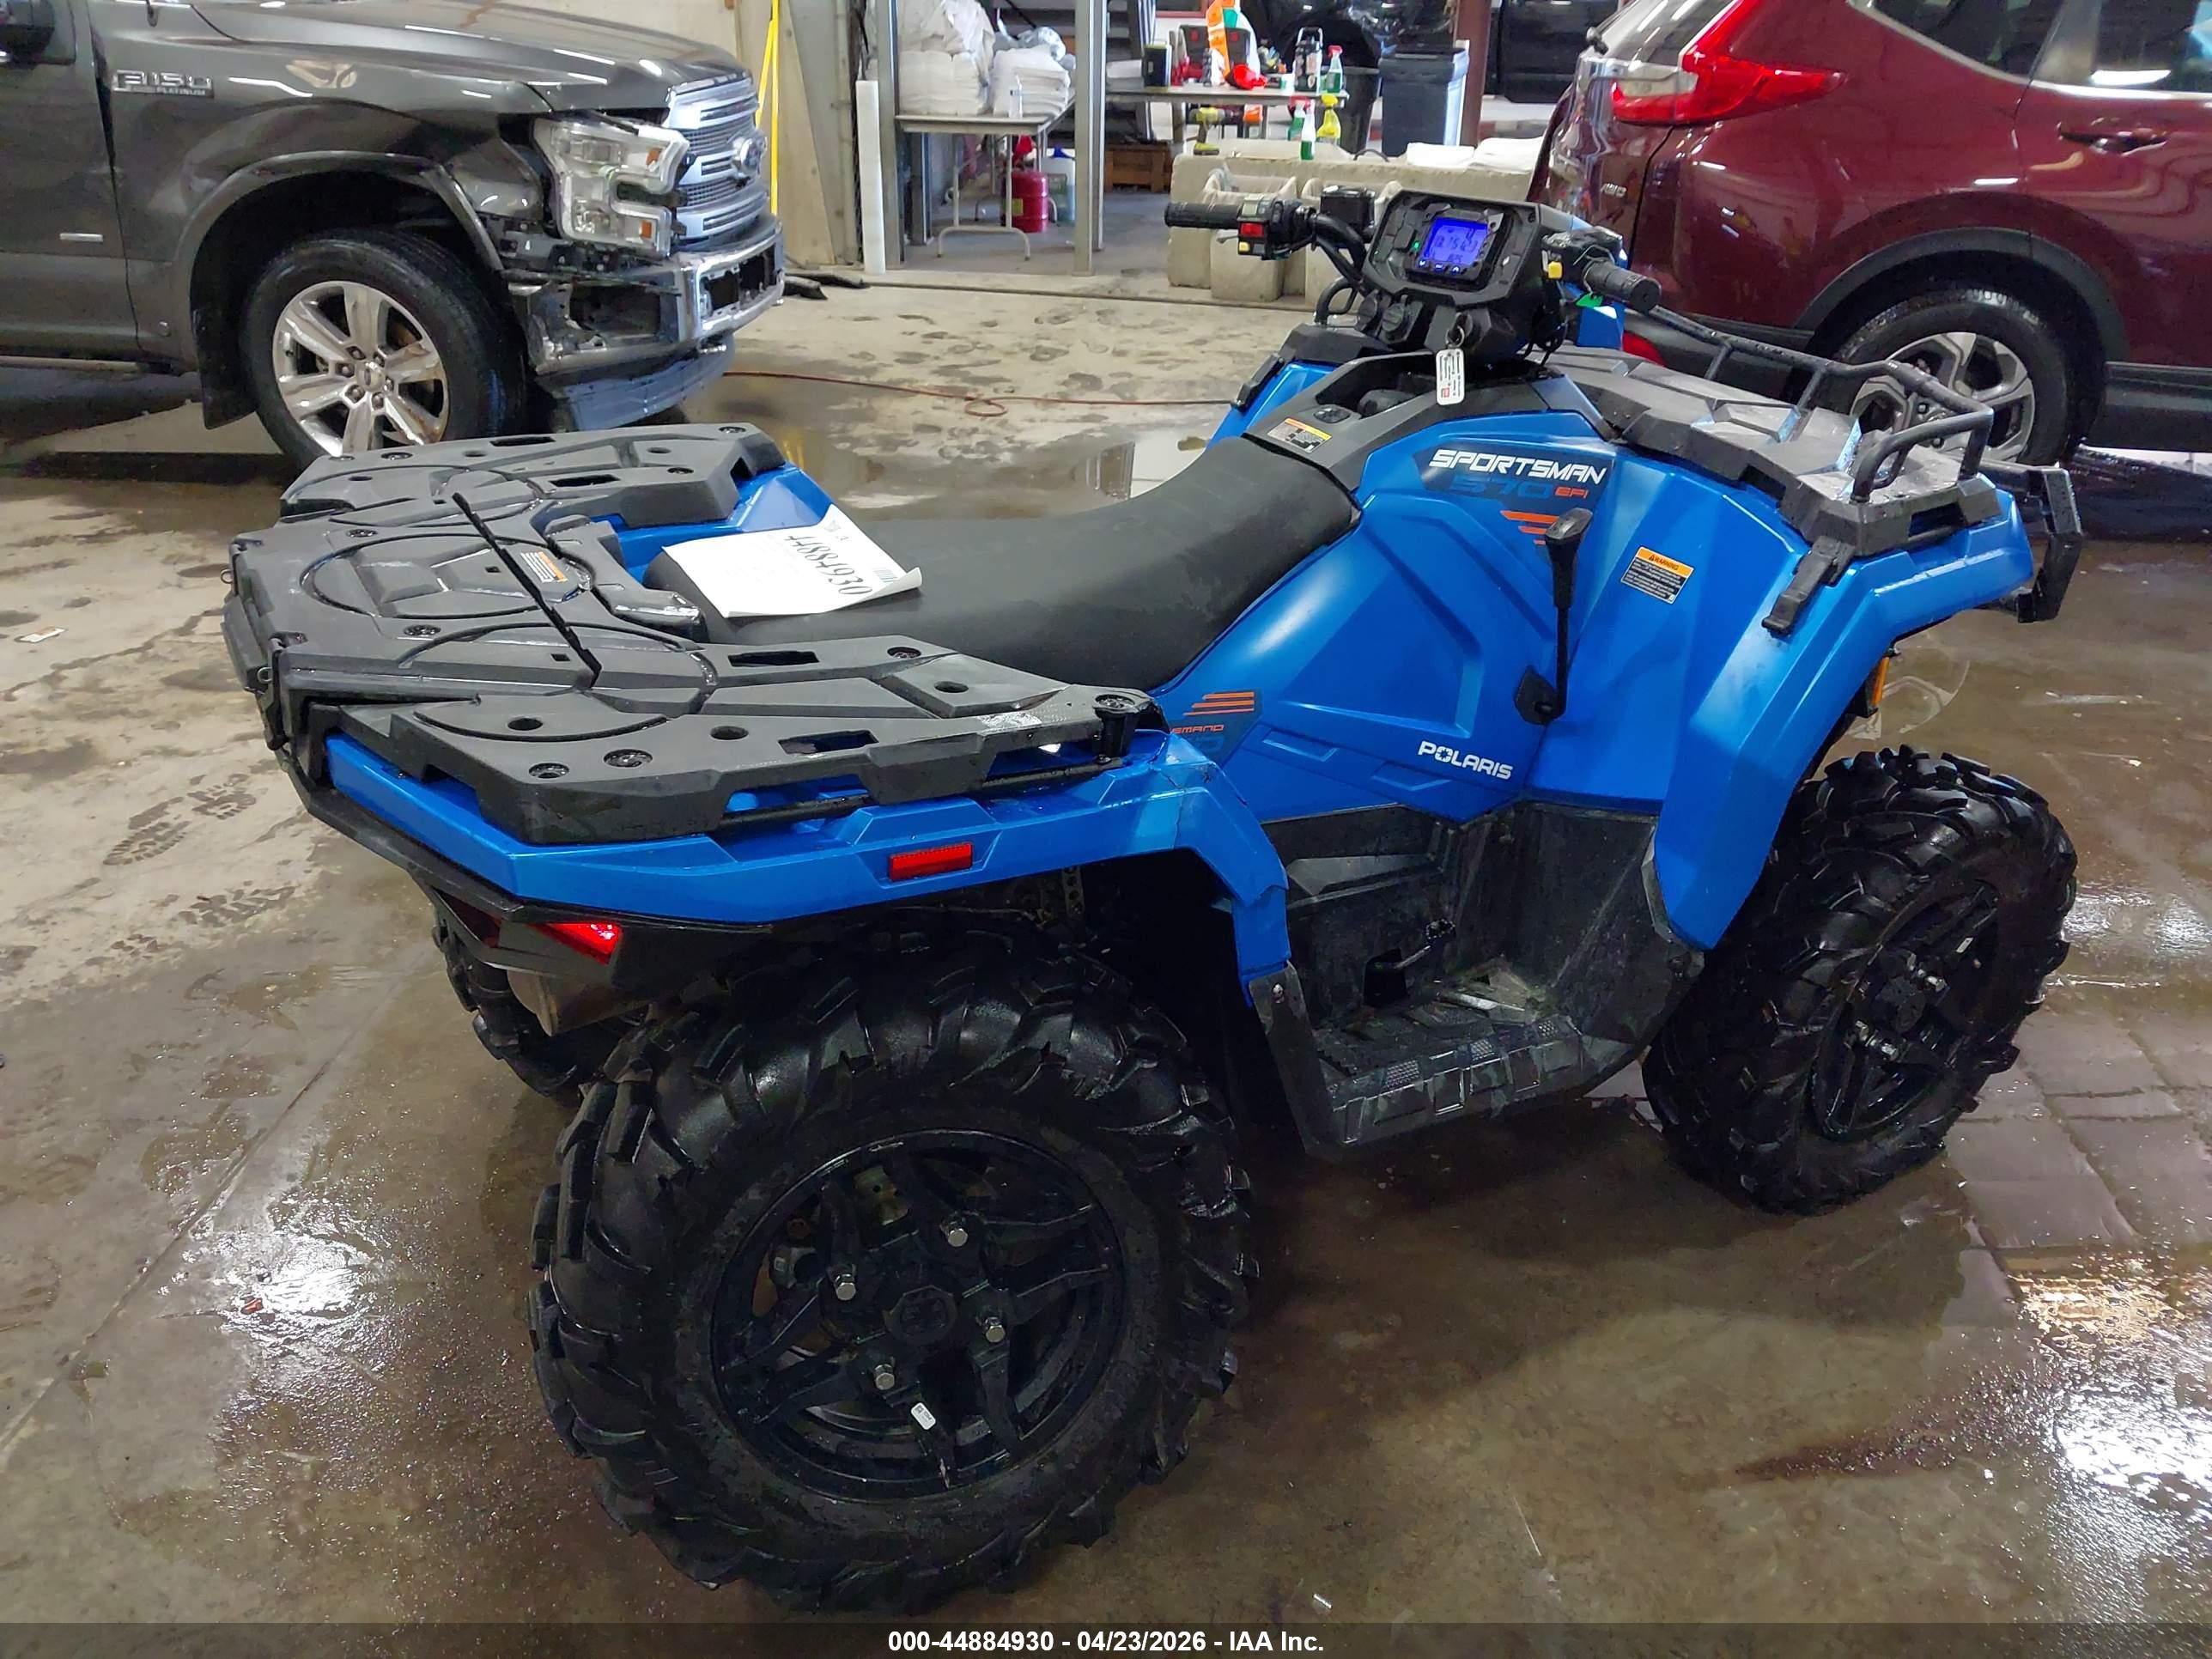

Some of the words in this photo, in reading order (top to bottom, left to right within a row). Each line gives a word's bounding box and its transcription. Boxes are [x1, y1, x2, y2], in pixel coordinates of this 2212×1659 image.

[1429, 448, 1608, 485] SPORTSMAN
[1450, 475, 1553, 499] 570
[1555, 487, 1589, 499] EFI
[784, 534, 873, 595] 44884930
[1170, 724, 1224, 734] EMAND
[1418, 740, 1514, 780] POLARIS
